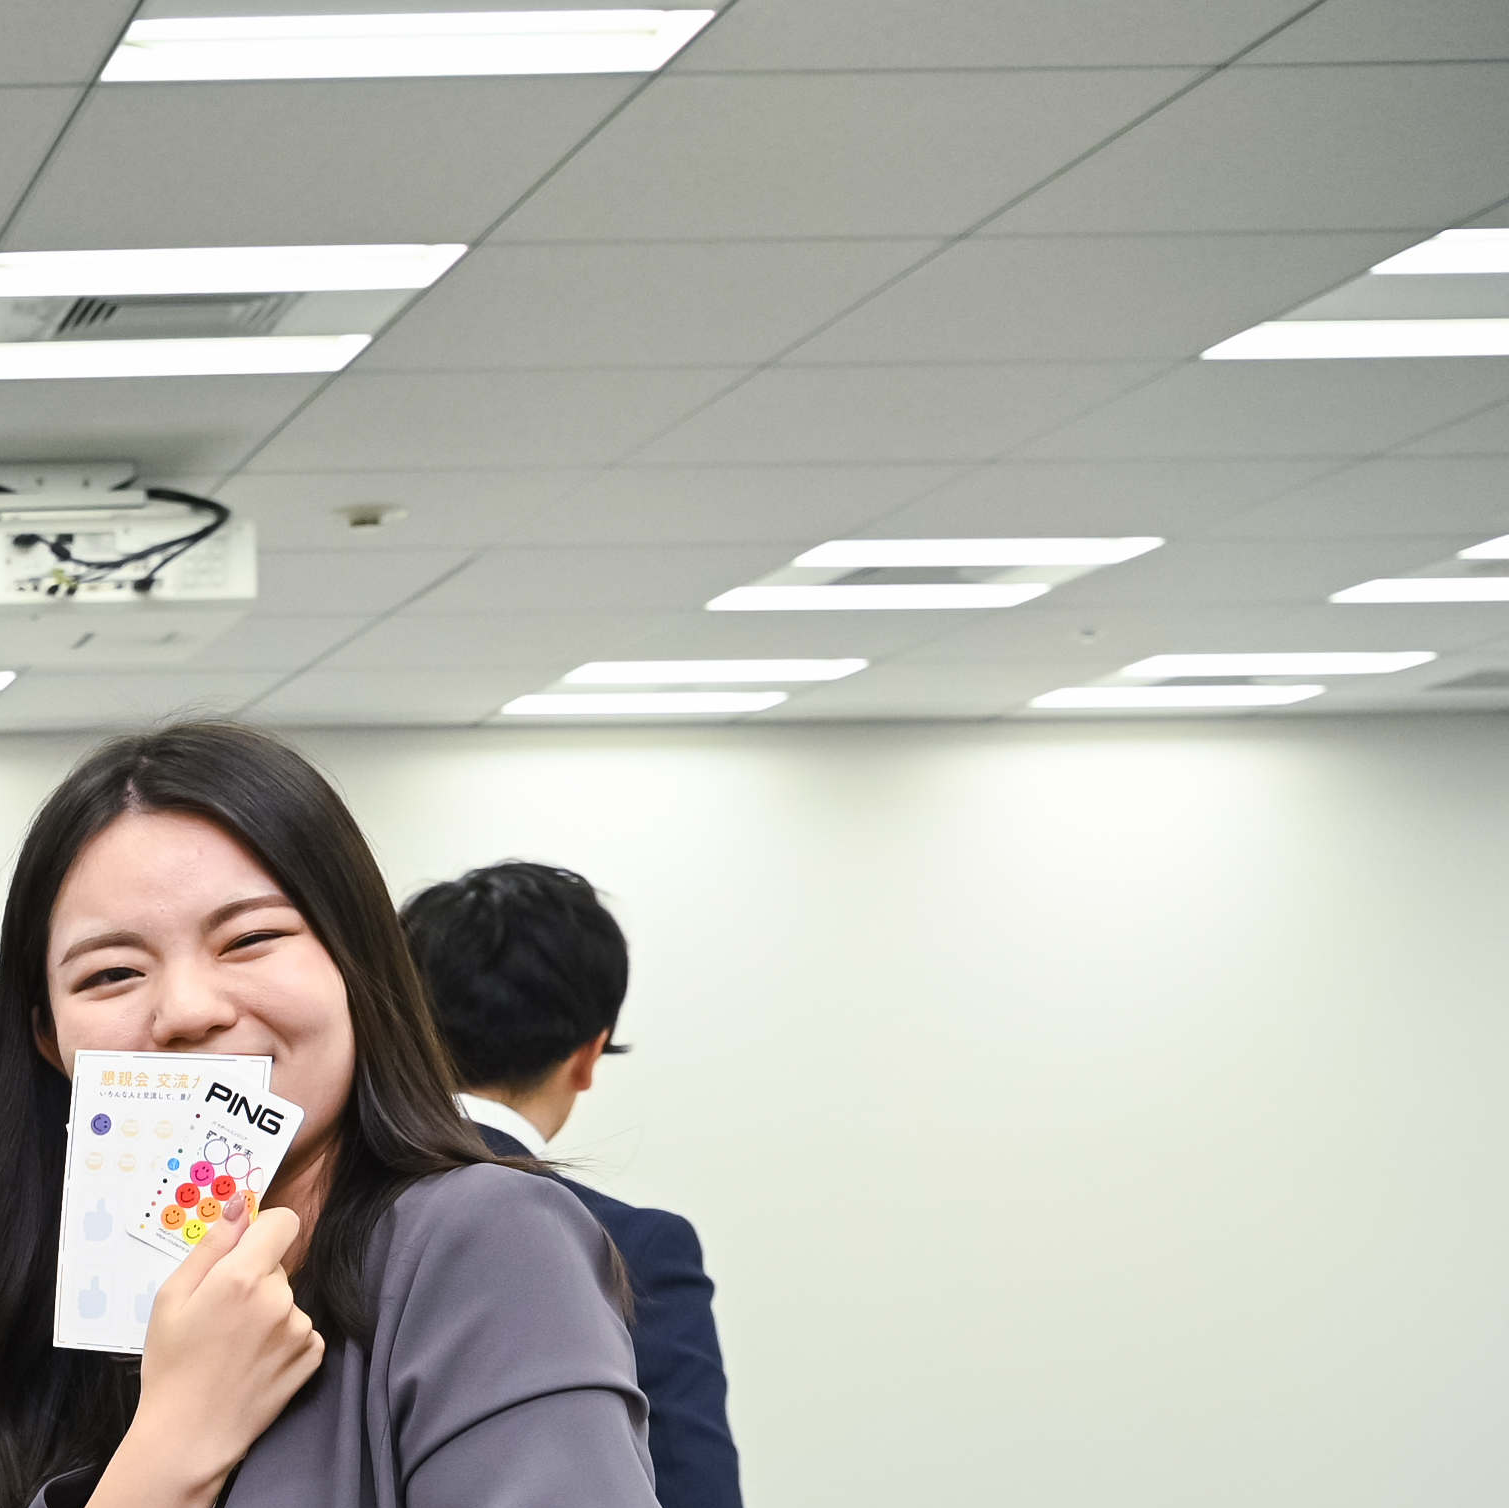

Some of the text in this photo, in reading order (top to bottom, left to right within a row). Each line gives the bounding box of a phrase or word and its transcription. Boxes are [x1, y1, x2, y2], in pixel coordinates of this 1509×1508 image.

[100, 1071, 149, 1087] 懇親会
[205, 1082, 285, 1136] PING
